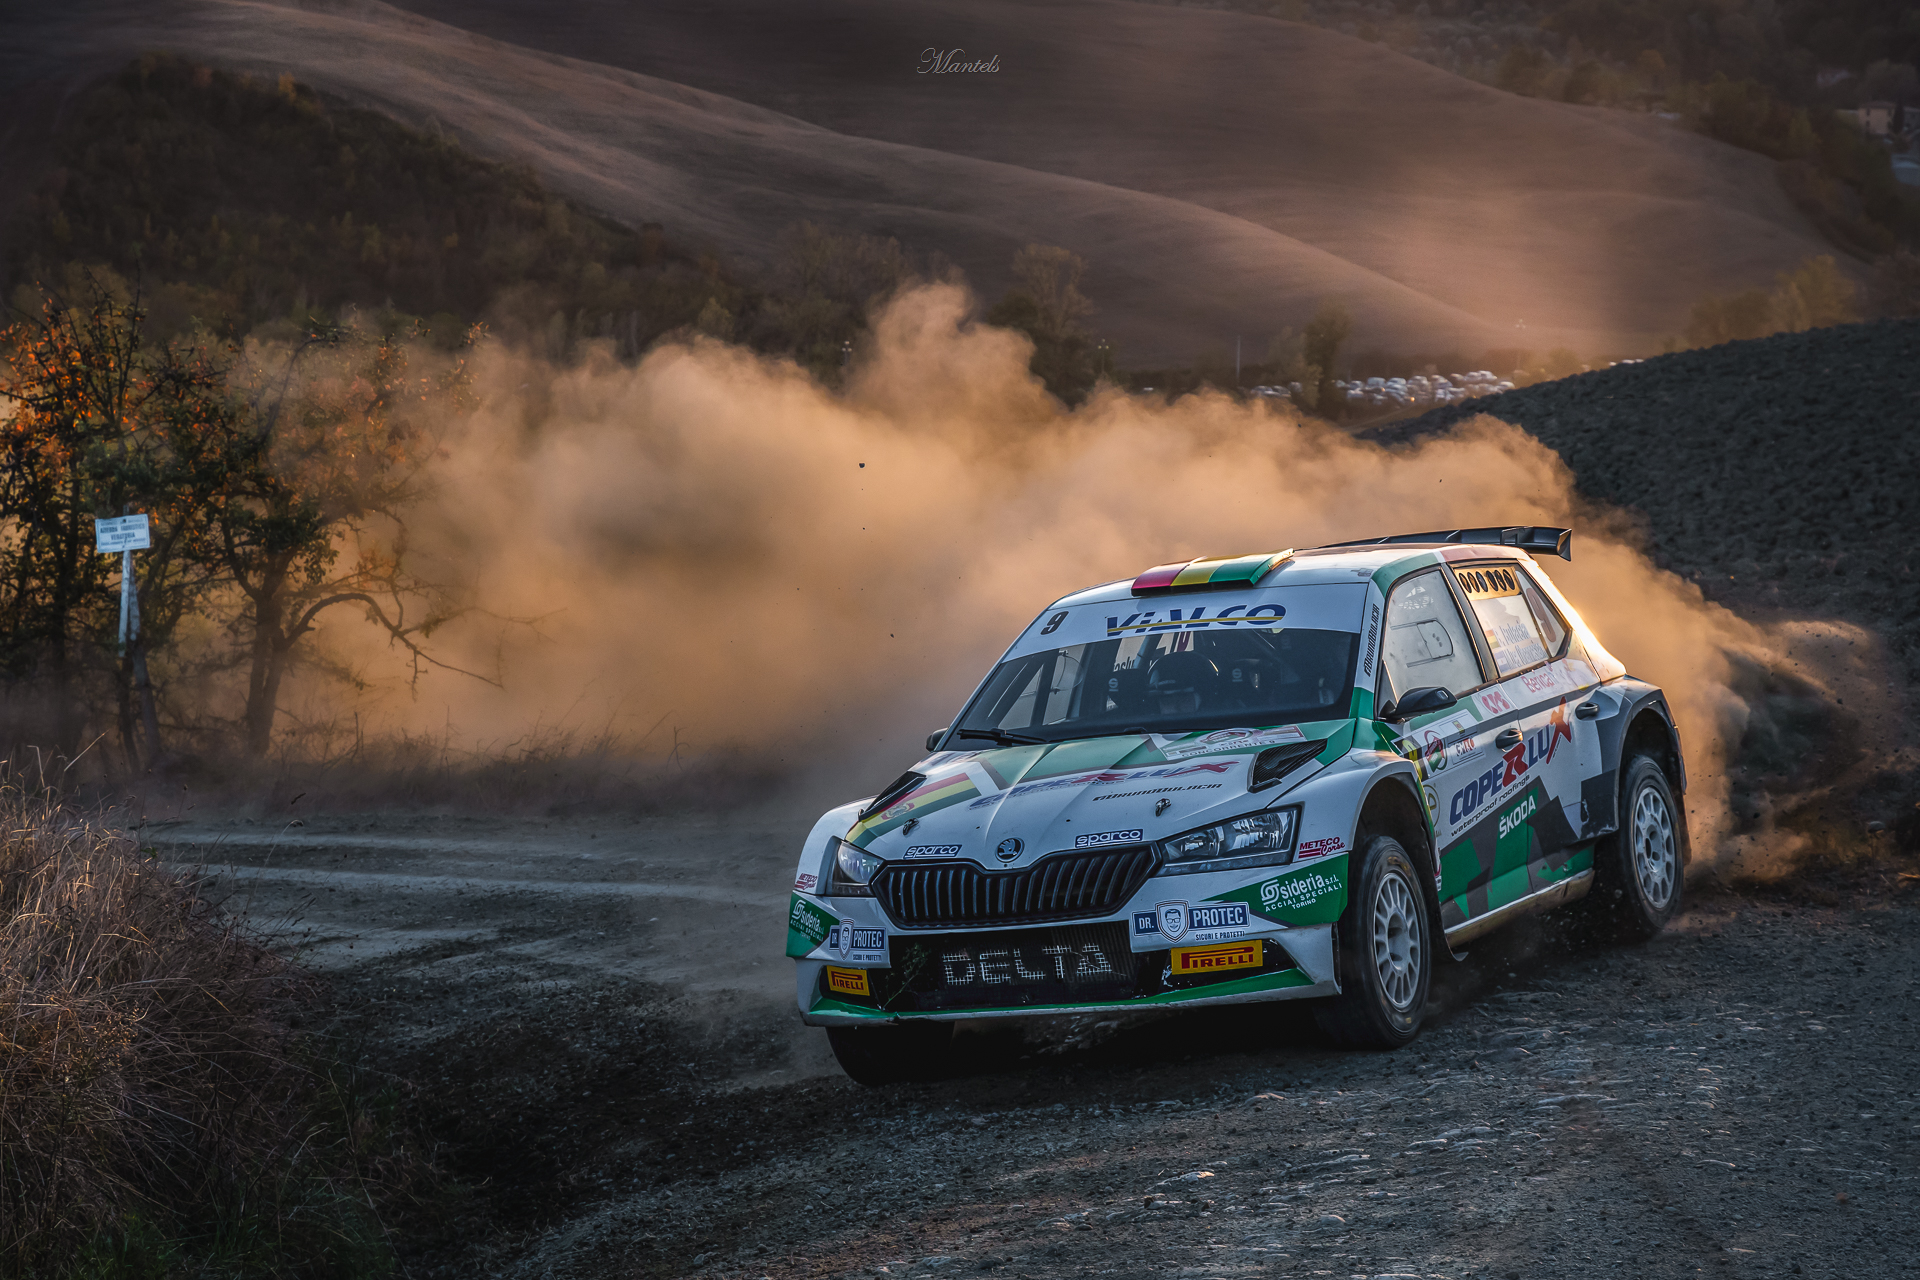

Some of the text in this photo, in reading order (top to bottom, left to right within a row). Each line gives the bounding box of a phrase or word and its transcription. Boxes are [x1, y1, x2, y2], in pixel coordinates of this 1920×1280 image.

[1040, 610, 1069, 635] 9
[1449, 696, 1572, 826] COPERLUX
[1451, 799, 1499, 837] waterproof
[1499, 794, 1537, 840] ŠKODA
[1076, 829, 1141, 847] sparco
[1299, 836, 1341, 850] METECO
[1320, 842, 1346, 857] Corse
[906, 844, 959, 858] sparco
[1265, 882, 1343, 913] ACCIAI SPECIALI
[1280, 872, 1326, 899] sideria
[1291, 898, 1317, 910] TORINO
[1138, 906, 1244, 931] DR. PROTEC
[853, 930, 882, 948] PROTEC
[1195, 933, 1214, 941] SICURI
[1219, 930, 1245, 939] PROTETTI
[942, 943, 1113, 986] DELTA
[1180, 946, 1255, 970] PIRELLI
[831, 971, 865, 991] PIRELLI
